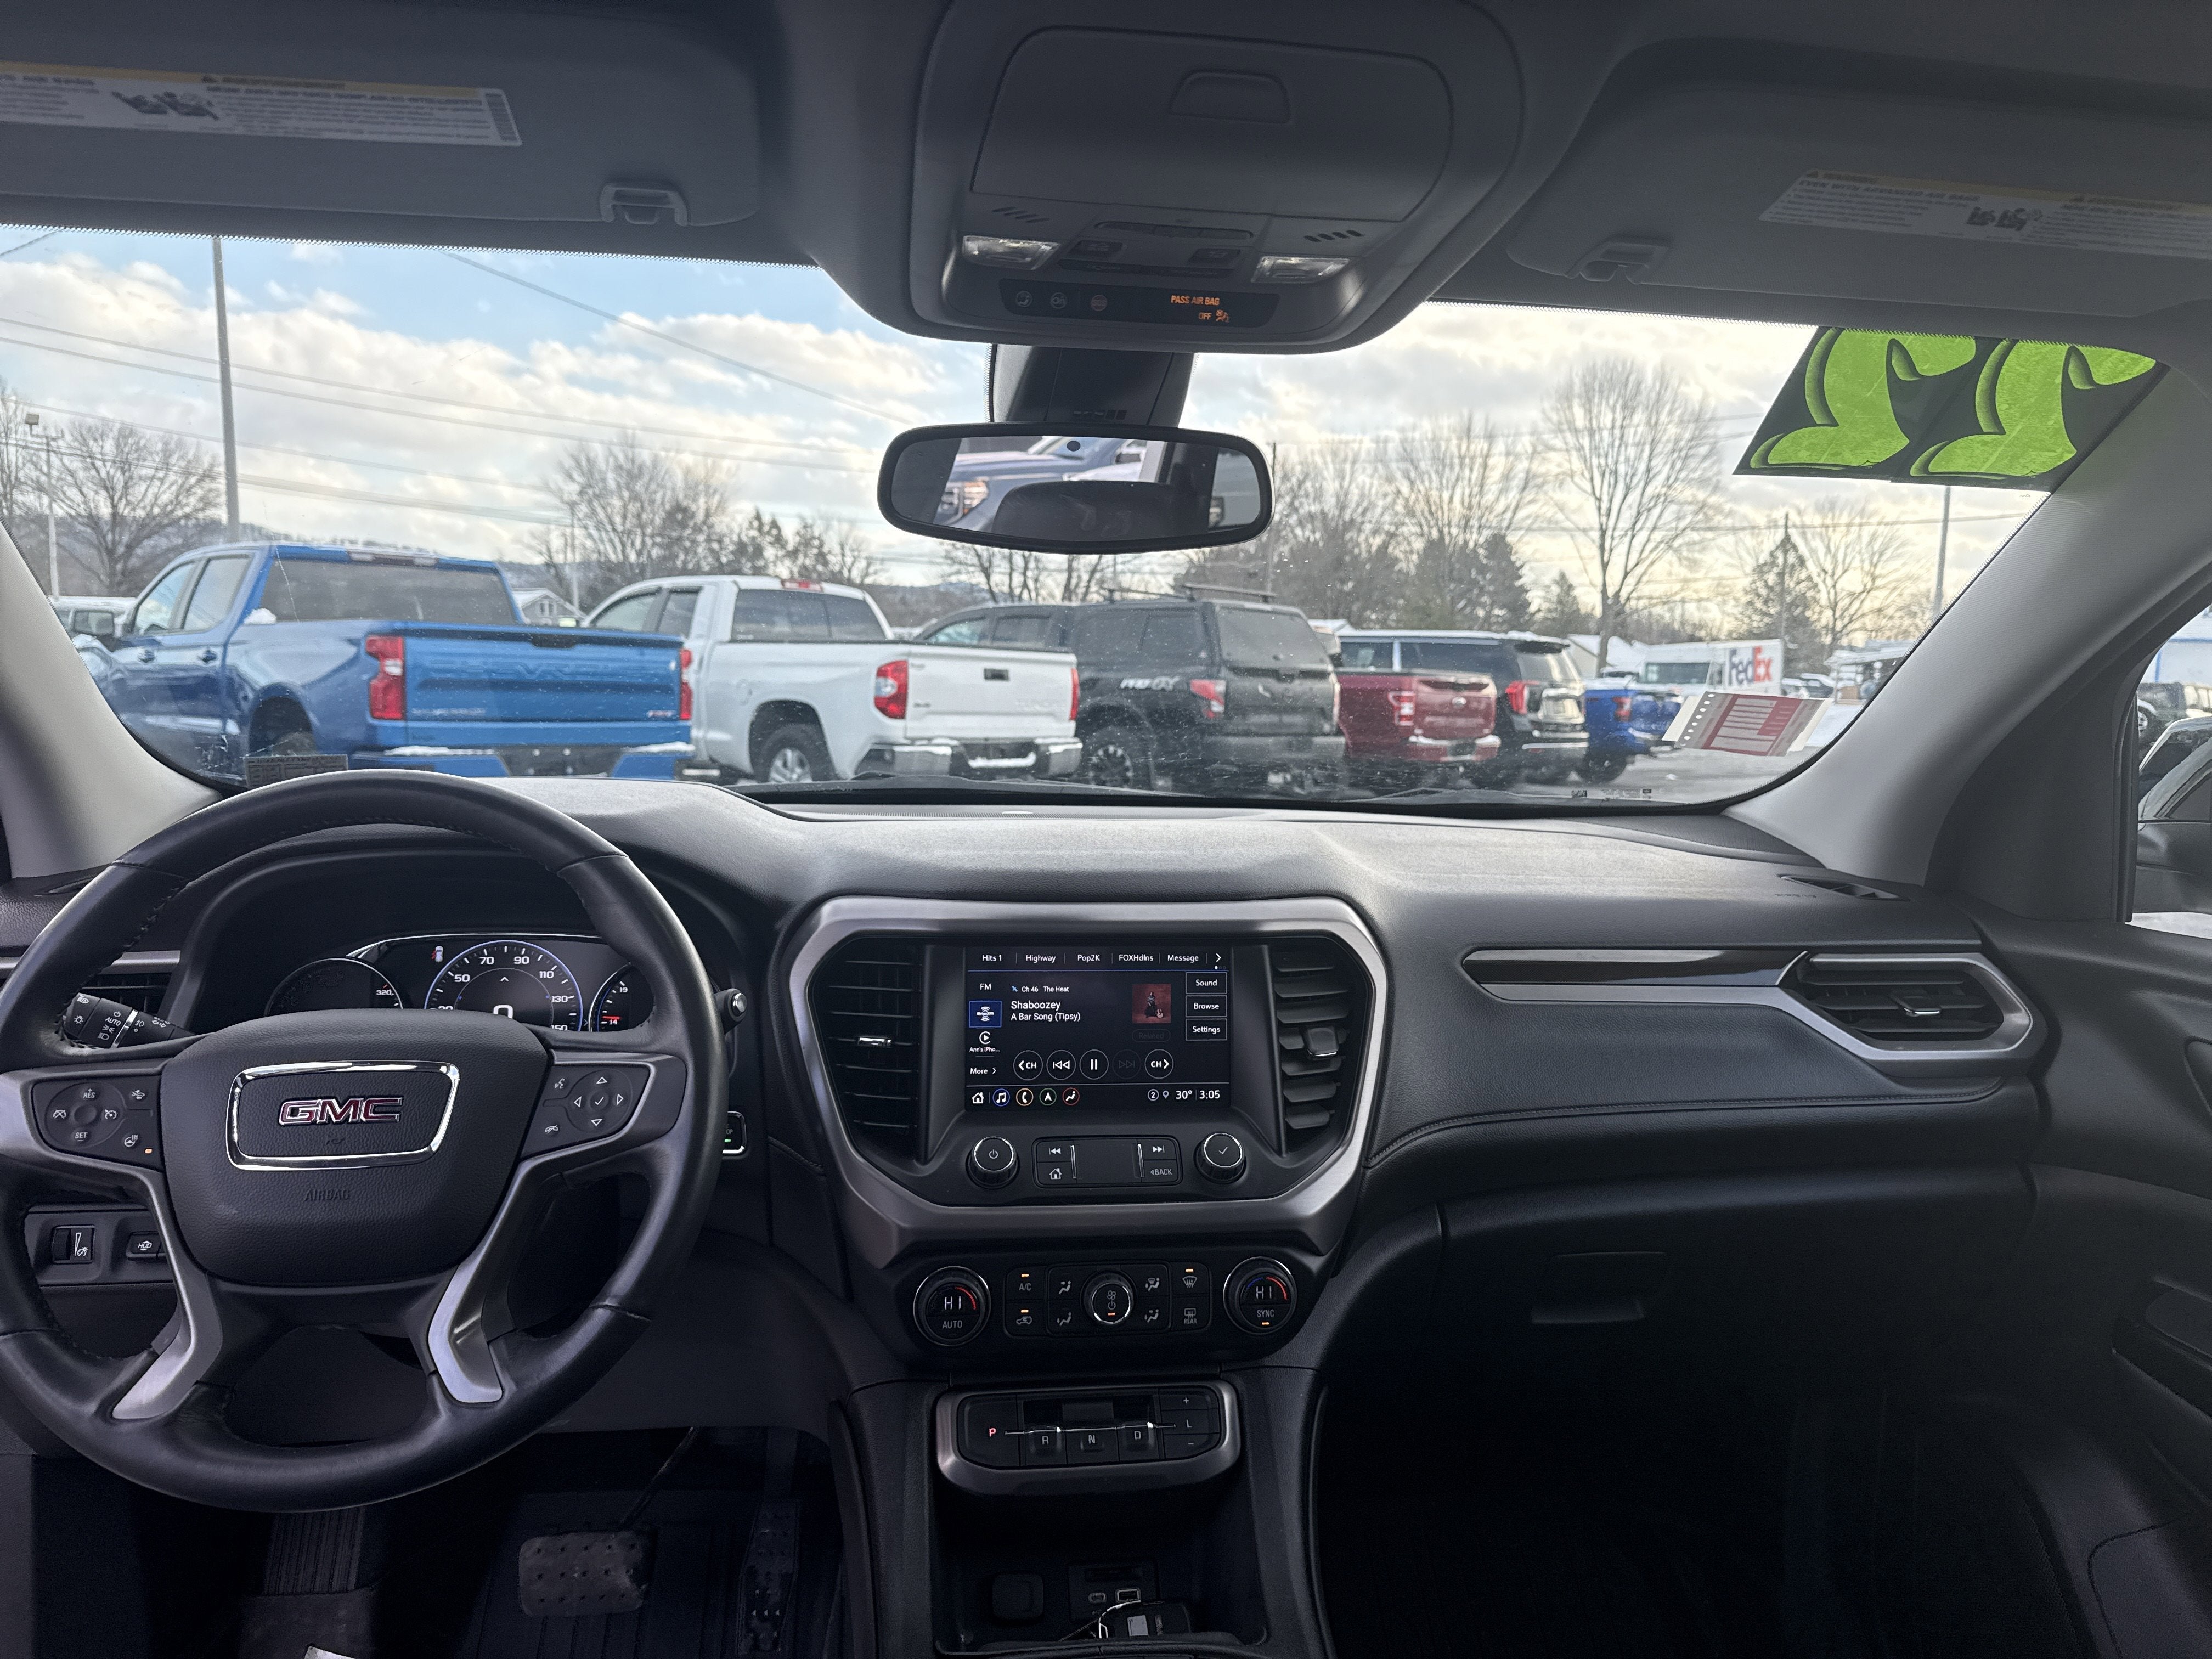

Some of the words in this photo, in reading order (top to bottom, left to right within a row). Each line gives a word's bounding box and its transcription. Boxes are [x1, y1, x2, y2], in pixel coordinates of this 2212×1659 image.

[1171, 295, 1190, 304] PASS
[1191, 296, 1204, 304] AIR
[1205, 297, 1220, 306] BAG
[1198, 312, 1212, 320] OFF
[1730, 646, 1773, 685] FedEx
[479, 956, 494, 964] 70
[514, 956, 529, 964] 90
[1025, 954, 1056, 963] Highway
[1077, 954, 1101, 963] Pop2K
[1167, 954, 1199, 963] Message
[454, 974, 470, 983] 50
[539, 970, 554, 979] 110
[1011, 1000, 1061, 1011] Shaboozey
[105, 1016, 121, 1027] AUTO
[1011, 1013, 1017, 1021] A
[1019, 1013, 1032, 1021] Bar
[1034, 1013, 1053, 1022] Song
[1054, 1012, 1081, 1022] (Tipsy)
[1192, 1025, 1221, 1034] Settings
[1199, 1090, 1221, 1099] 3:05
[279, 1097, 403, 1126] GMC
[75, 1132, 88, 1140] SET
[1154, 1168, 1172, 1176] BACK
[304, 1188, 351, 1202] AIRBAG
[1018, 1282, 1032, 1292] A/C
[1256, 1308, 1275, 1318] SYNC
[942, 1319, 963, 1329] AUTO
[1186, 1419, 1192, 1429] L
[989, 1427, 996, 1437] P
[1134, 1431, 1142, 1440] D
[1042, 1436, 1049, 1445] R
[1088, 1434, 1096, 1445] N
